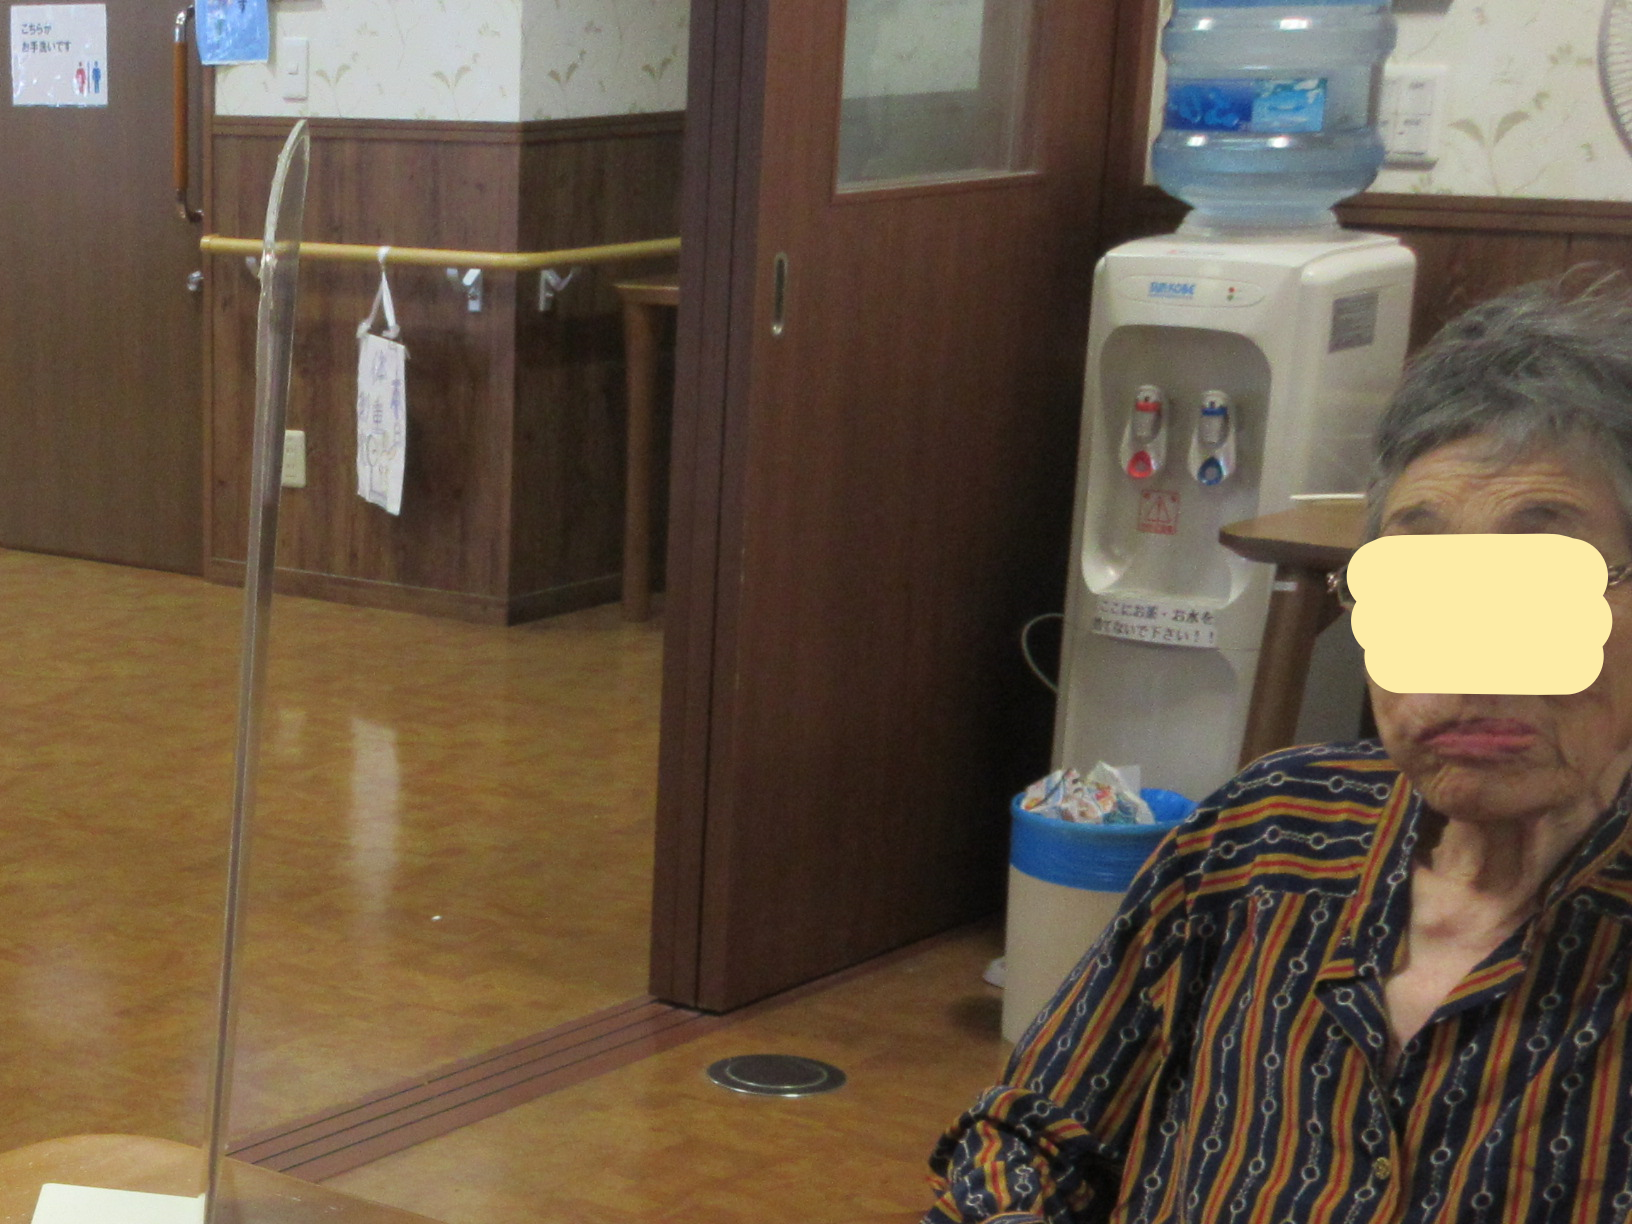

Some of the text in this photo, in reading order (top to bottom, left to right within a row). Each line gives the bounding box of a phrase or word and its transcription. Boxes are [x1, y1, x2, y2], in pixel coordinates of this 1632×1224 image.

[21, 41, 72, 53] お手洗いです
